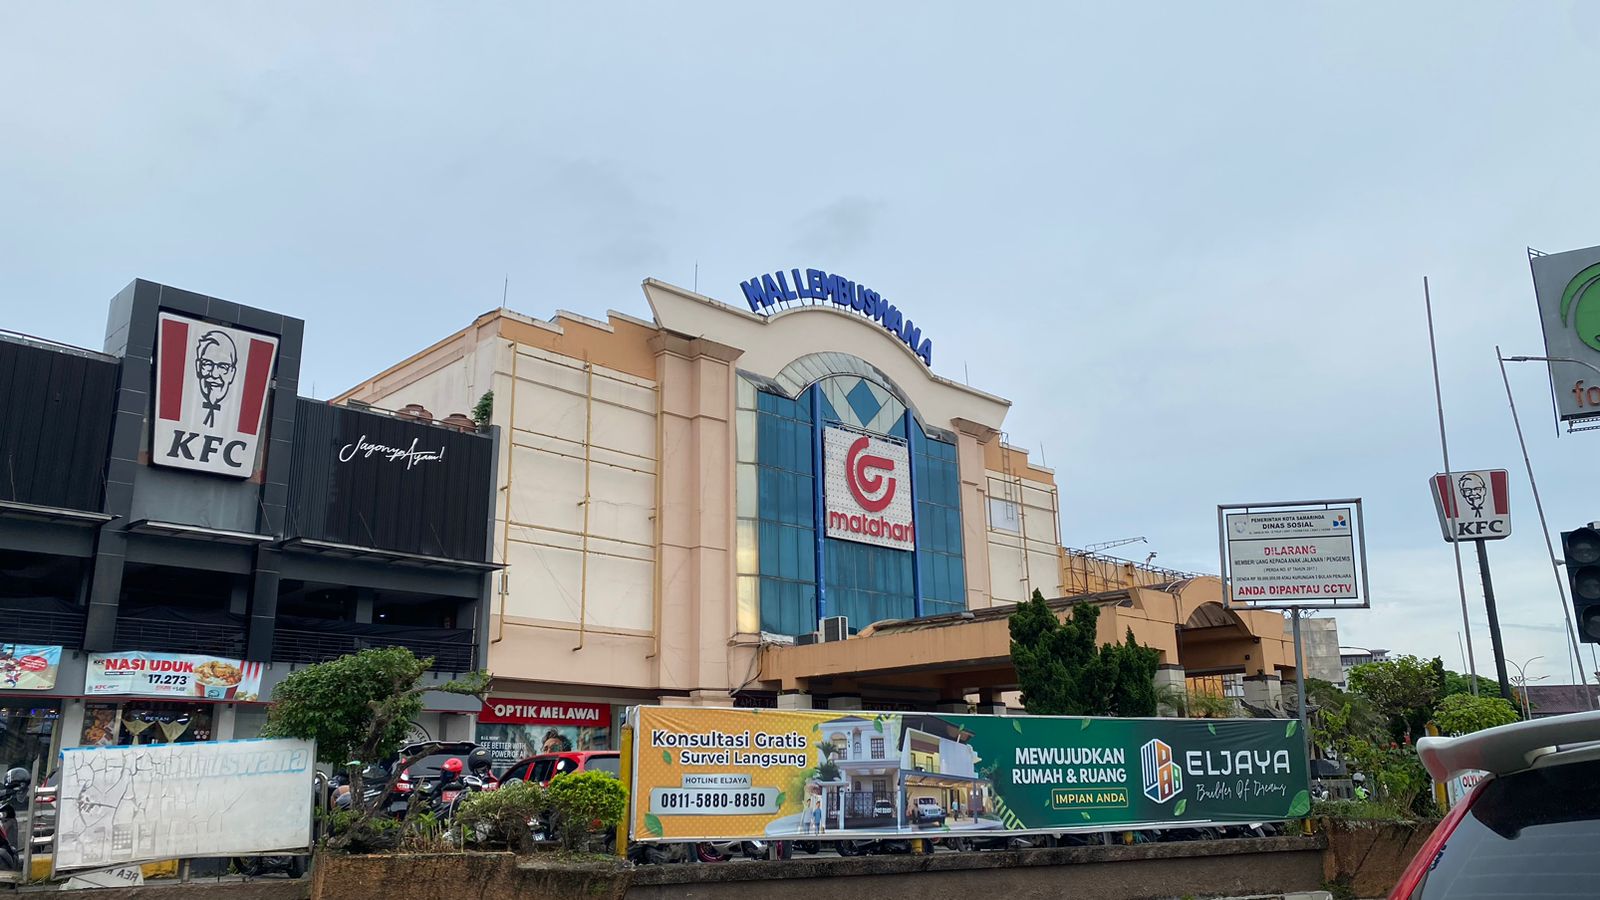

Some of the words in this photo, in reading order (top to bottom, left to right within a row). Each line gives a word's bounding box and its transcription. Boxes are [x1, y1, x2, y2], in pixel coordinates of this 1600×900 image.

[167, 429, 247, 468] KFC
[1262, 522, 1285, 530] DINAS
[1286, 521, 1314, 529] SOSIAL
[1458, 519, 1504, 536] KFC
[1264, 545, 1317, 556] DILARANG
[1238, 586, 1266, 596] ANDA
[1269, 585, 1320, 595] DIPANTAU
[1323, 584, 1352, 594] CCTV
[105, 658, 146, 671] NASI
[149, 660, 194, 673] UDUK
[494, 704, 537, 718] OPTIK
[539, 706, 599, 721] MELAWAI
[480, 741, 491, 749] SEE
[491, 741, 512, 750] BETTER
[512, 742, 527, 750] WITH
[652, 730, 749, 748] Konsultasi
[754, 732, 807, 748] Gratis
[491, 750, 511, 758] POWER
[680, 750, 730, 766] Survei
[733, 751, 807, 768] Langsung
[1015, 747, 1125, 765] MEWUJUDKAN
[1185, 750, 1290, 775] ELJAYA
[685, 777, 718, 785] HOTLINE
[719, 776, 748, 785] ELJAYA
[1012, 768, 1063, 784] RUMAH
[1066, 769, 1077, 783] &
[1080, 767, 1127, 784] RUANG
[661, 792, 766, 809] 0811-5880-8850
[1055, 793, 1093, 805] IMPIAN
[1096, 792, 1126, 804] ANDA
